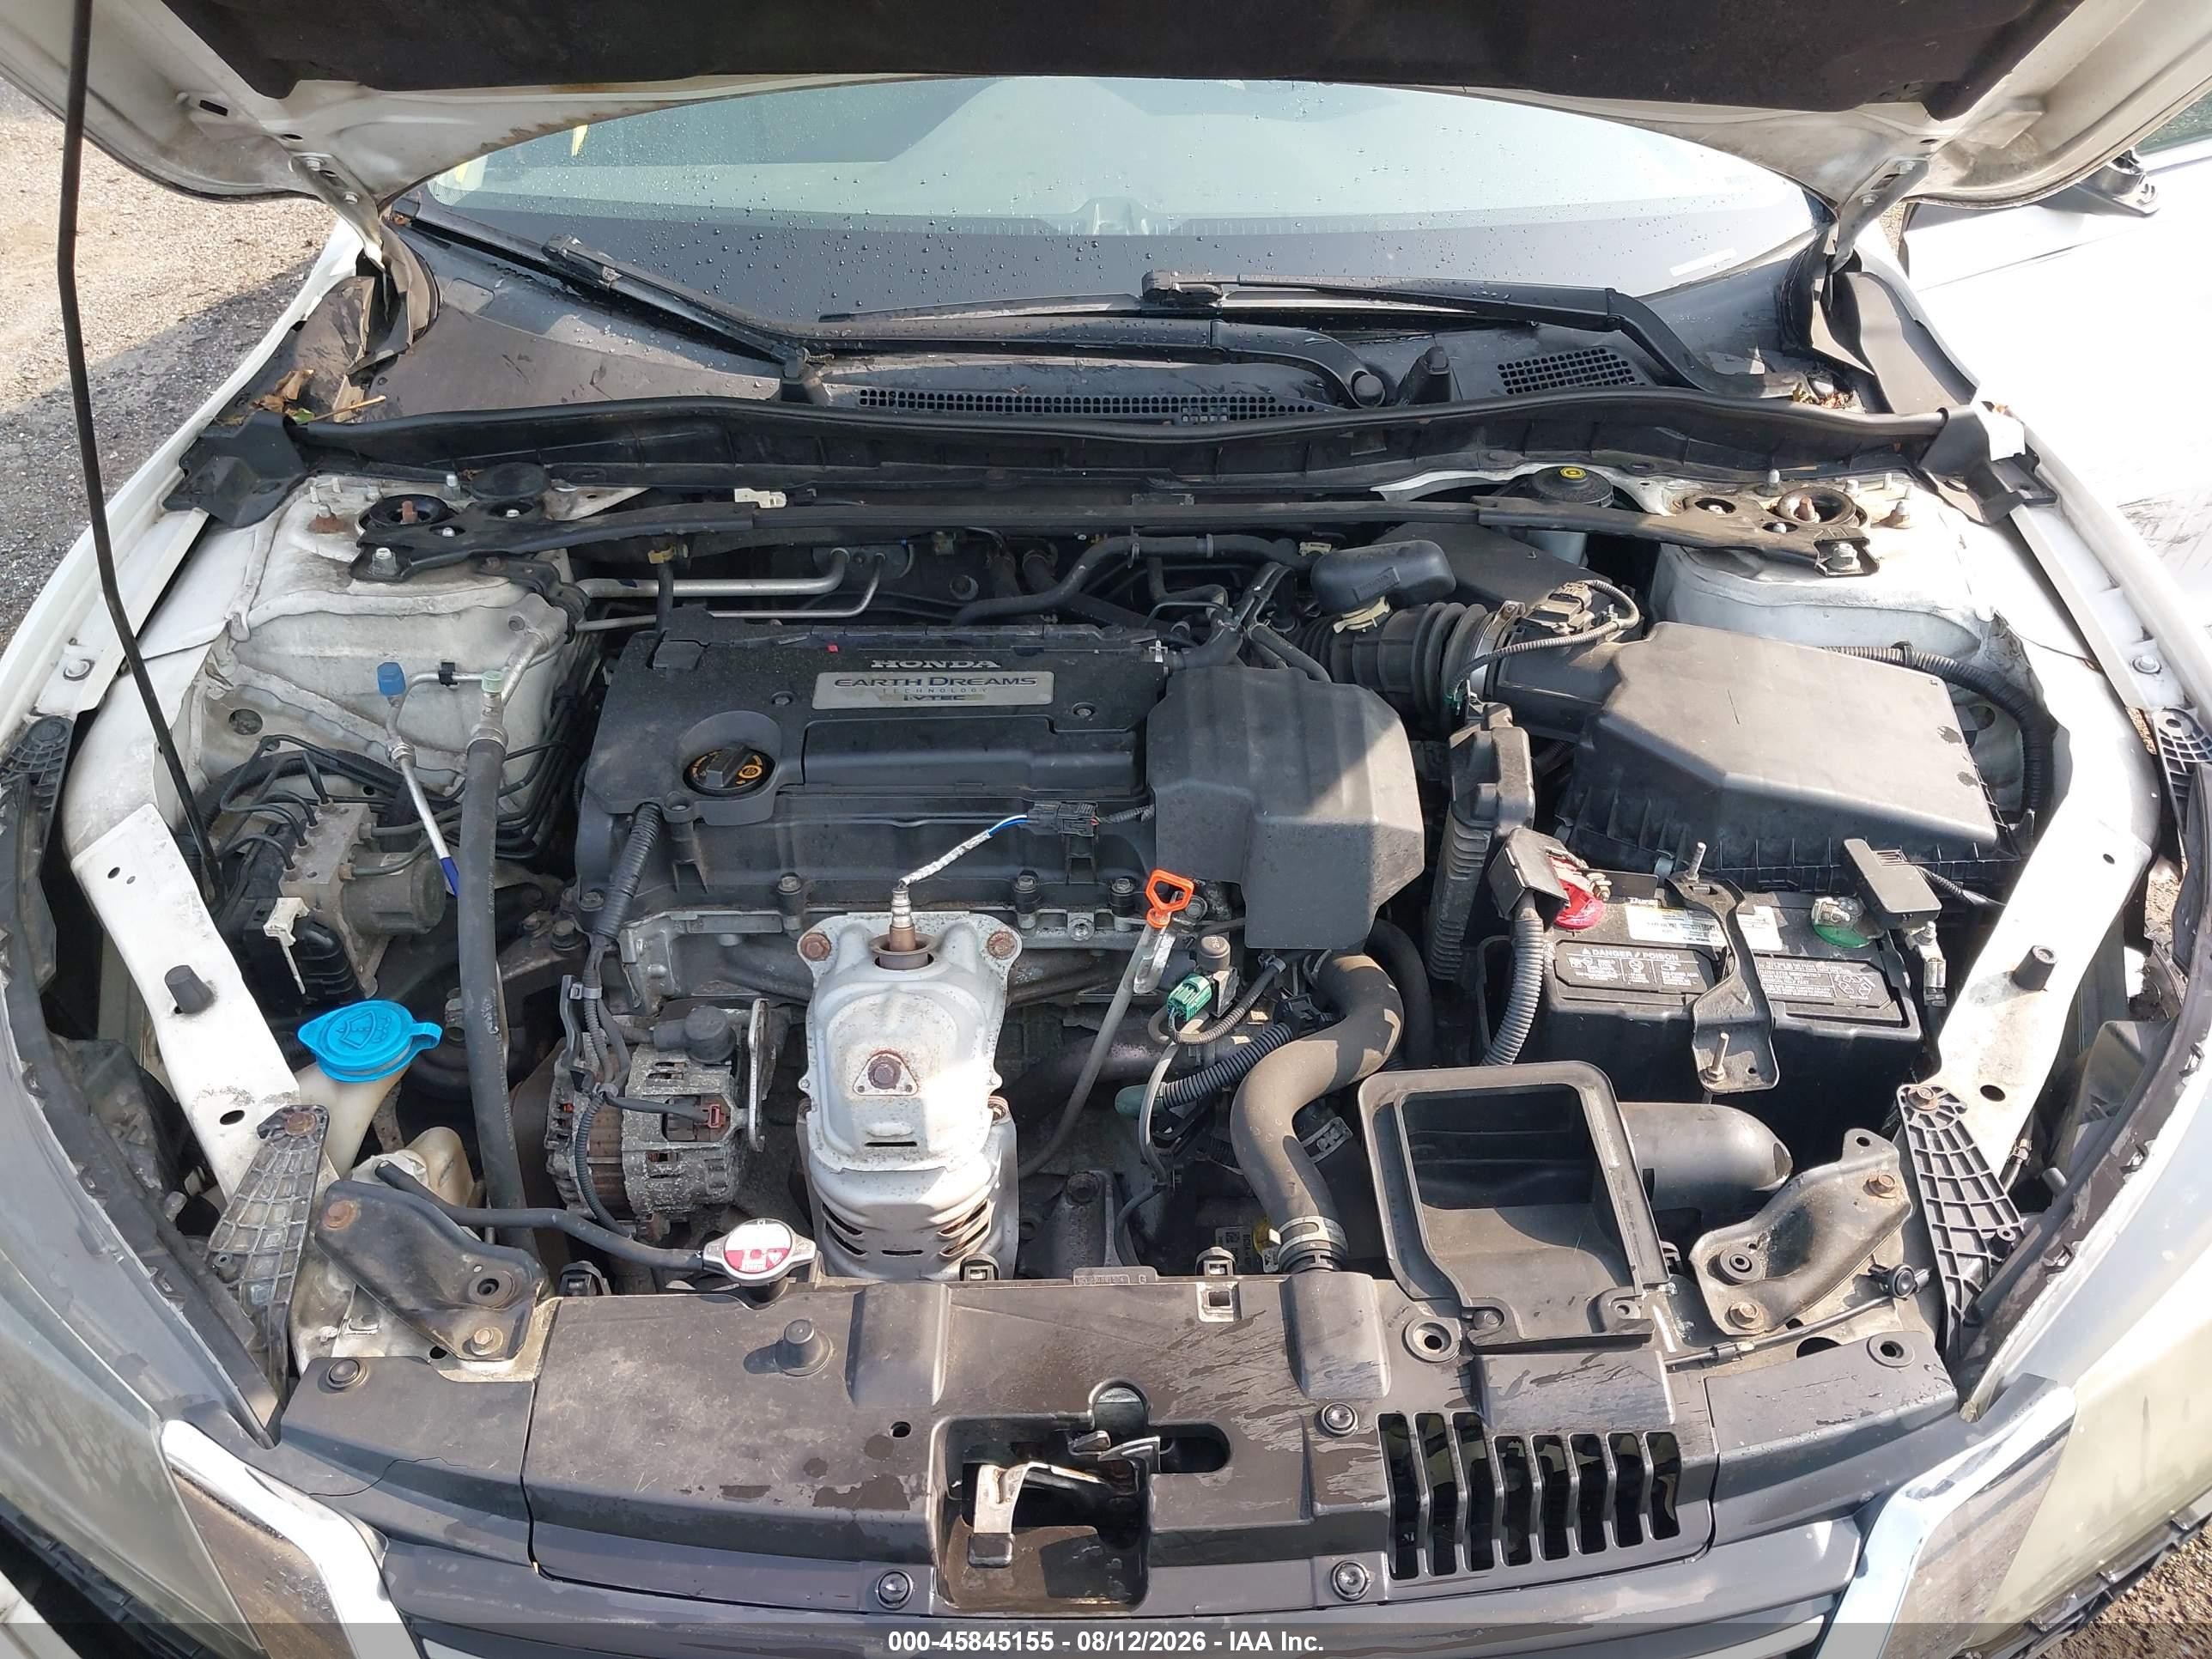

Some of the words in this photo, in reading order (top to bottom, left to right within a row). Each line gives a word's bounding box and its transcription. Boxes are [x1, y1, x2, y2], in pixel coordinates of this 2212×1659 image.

[871, 659, 1000, 668] HONDA
[834, 678, 921, 687] EARTH
[929, 677, 1037, 686] DREAMS
[1592, 948, 1632, 957] DANGER
[1643, 951, 1679, 961] POISON
